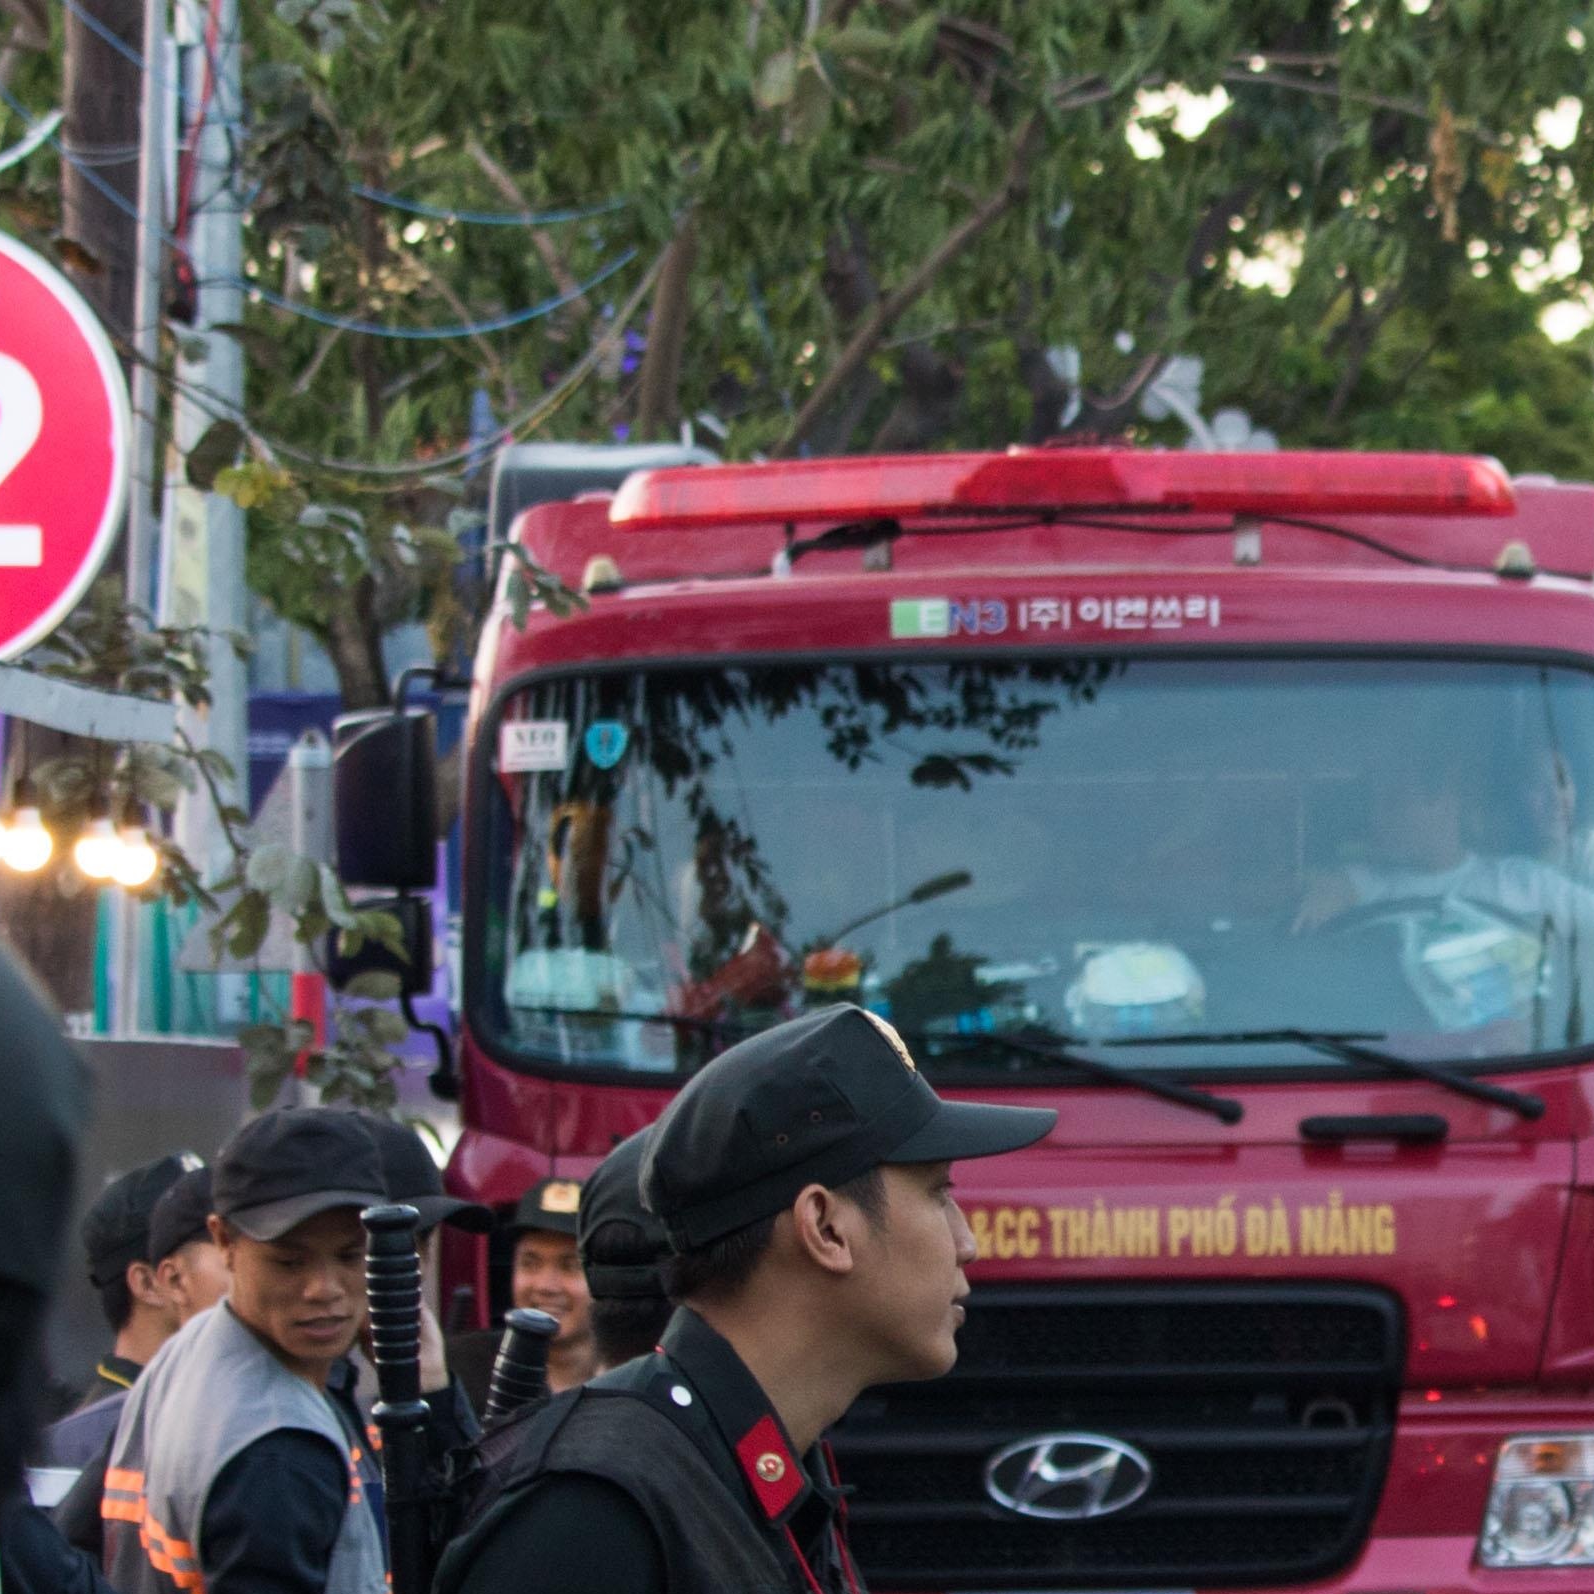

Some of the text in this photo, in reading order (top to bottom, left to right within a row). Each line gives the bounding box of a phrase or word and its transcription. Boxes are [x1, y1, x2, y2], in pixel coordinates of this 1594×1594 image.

[1048, 1198, 1160, 1258] THÀNH
[1169, 1192, 1237, 1258] PHỐ
[1245, 1197, 1292, 1257] ĐÀ
